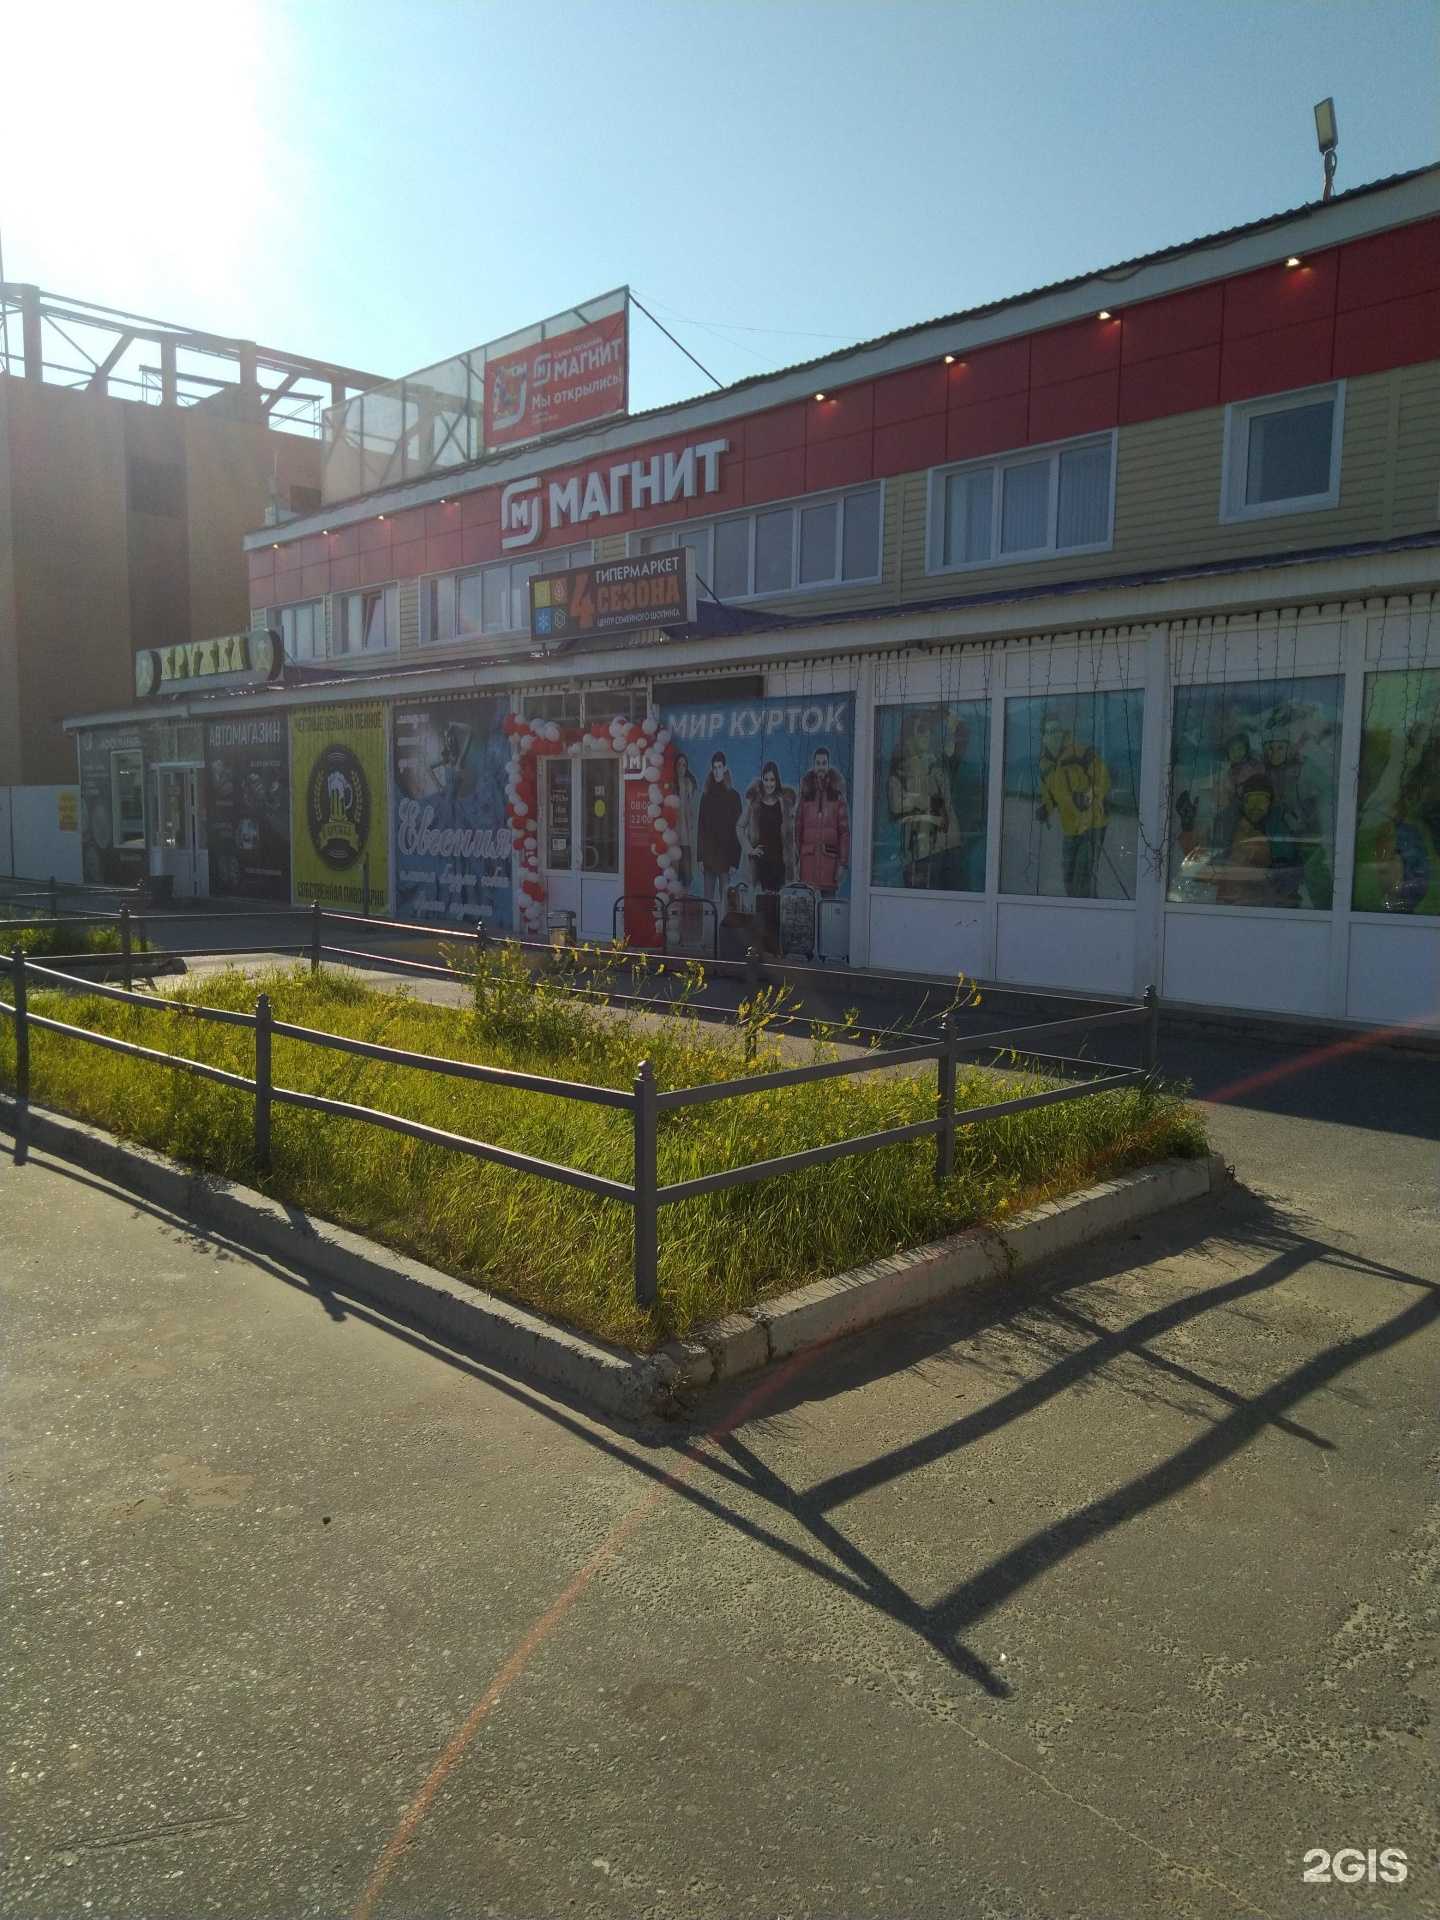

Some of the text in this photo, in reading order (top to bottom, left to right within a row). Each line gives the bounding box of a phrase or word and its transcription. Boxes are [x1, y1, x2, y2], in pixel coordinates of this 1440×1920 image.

[554, 337, 623, 382] МАГНИТ
[531, 393, 551, 411] Мы
[550, 438, 730, 529] МАГНИТ
[595, 556, 680, 585] ГИПЕРМАРКЕТ
[569, 572, 594, 630] 4
[209, 719, 281, 747] АВТОМАГАЗИН
[670, 703, 846, 739] МИР КУРТОК
